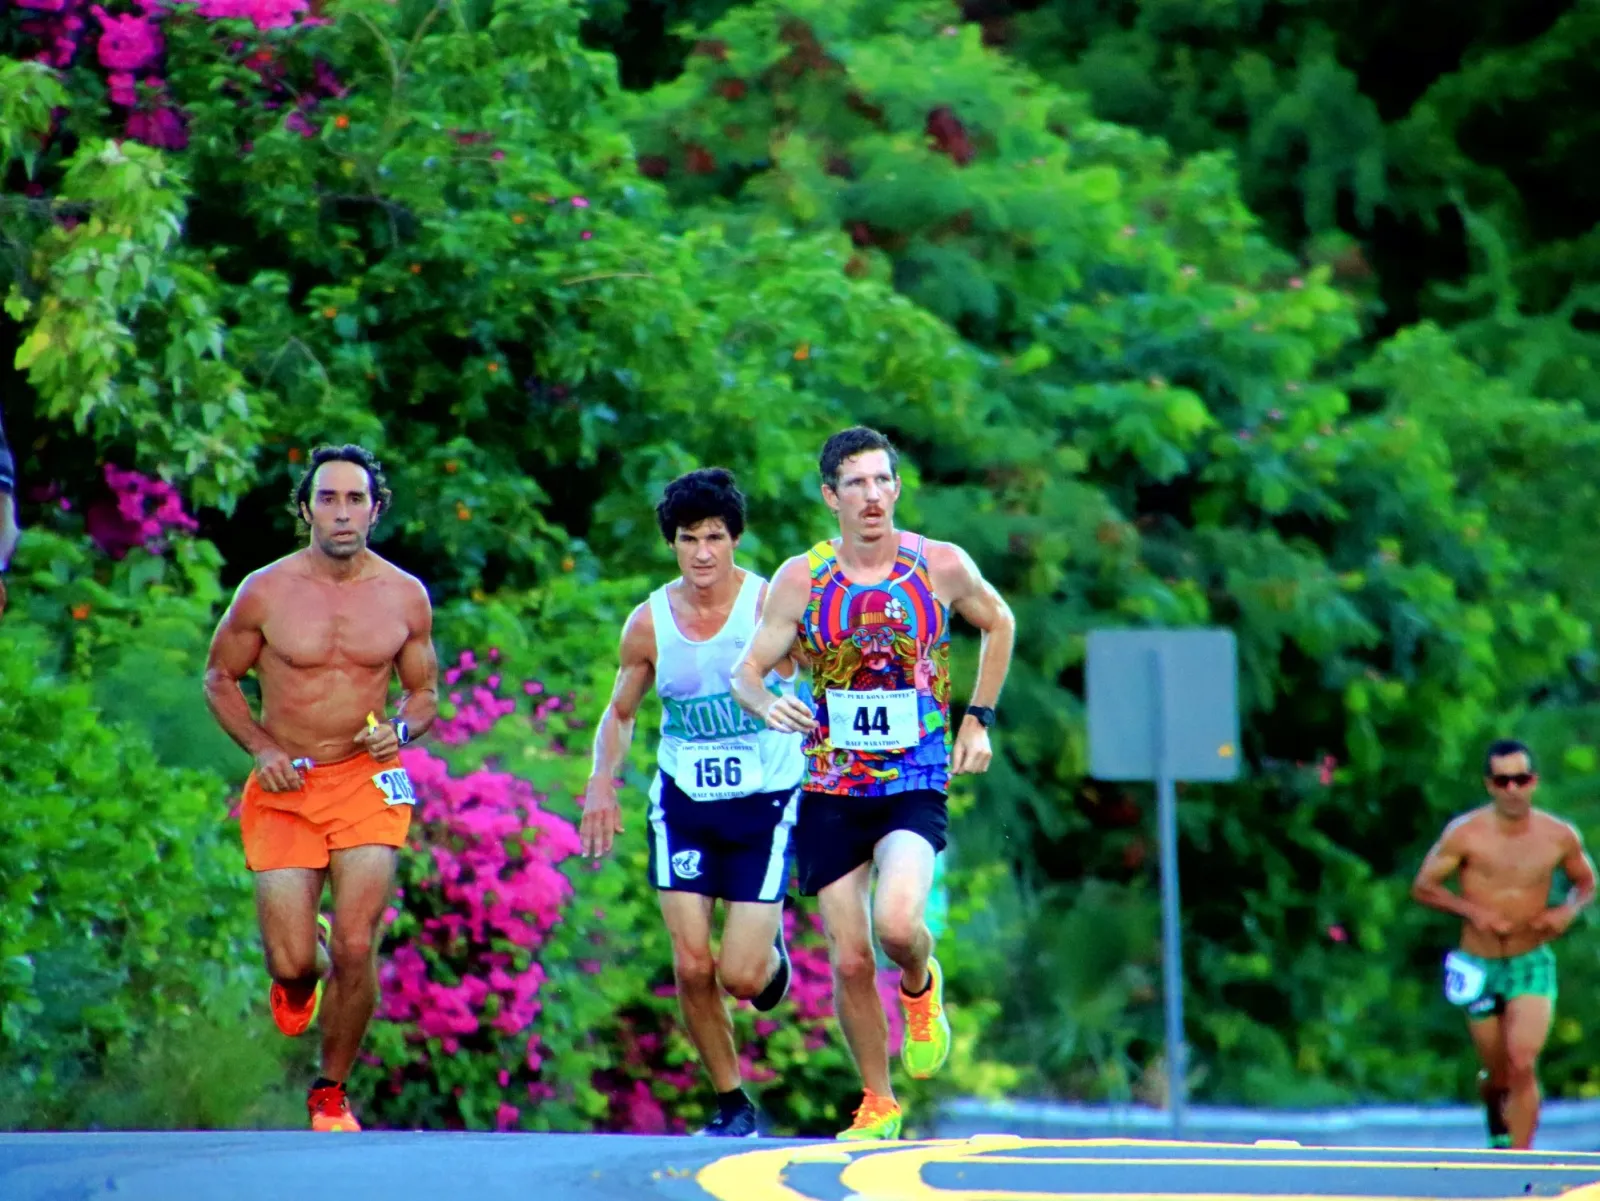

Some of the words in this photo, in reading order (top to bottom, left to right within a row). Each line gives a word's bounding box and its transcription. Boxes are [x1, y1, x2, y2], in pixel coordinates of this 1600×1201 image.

[676, 697, 758, 737] KONA
[853, 706, 891, 736] 44
[694, 756, 742, 788] 156
